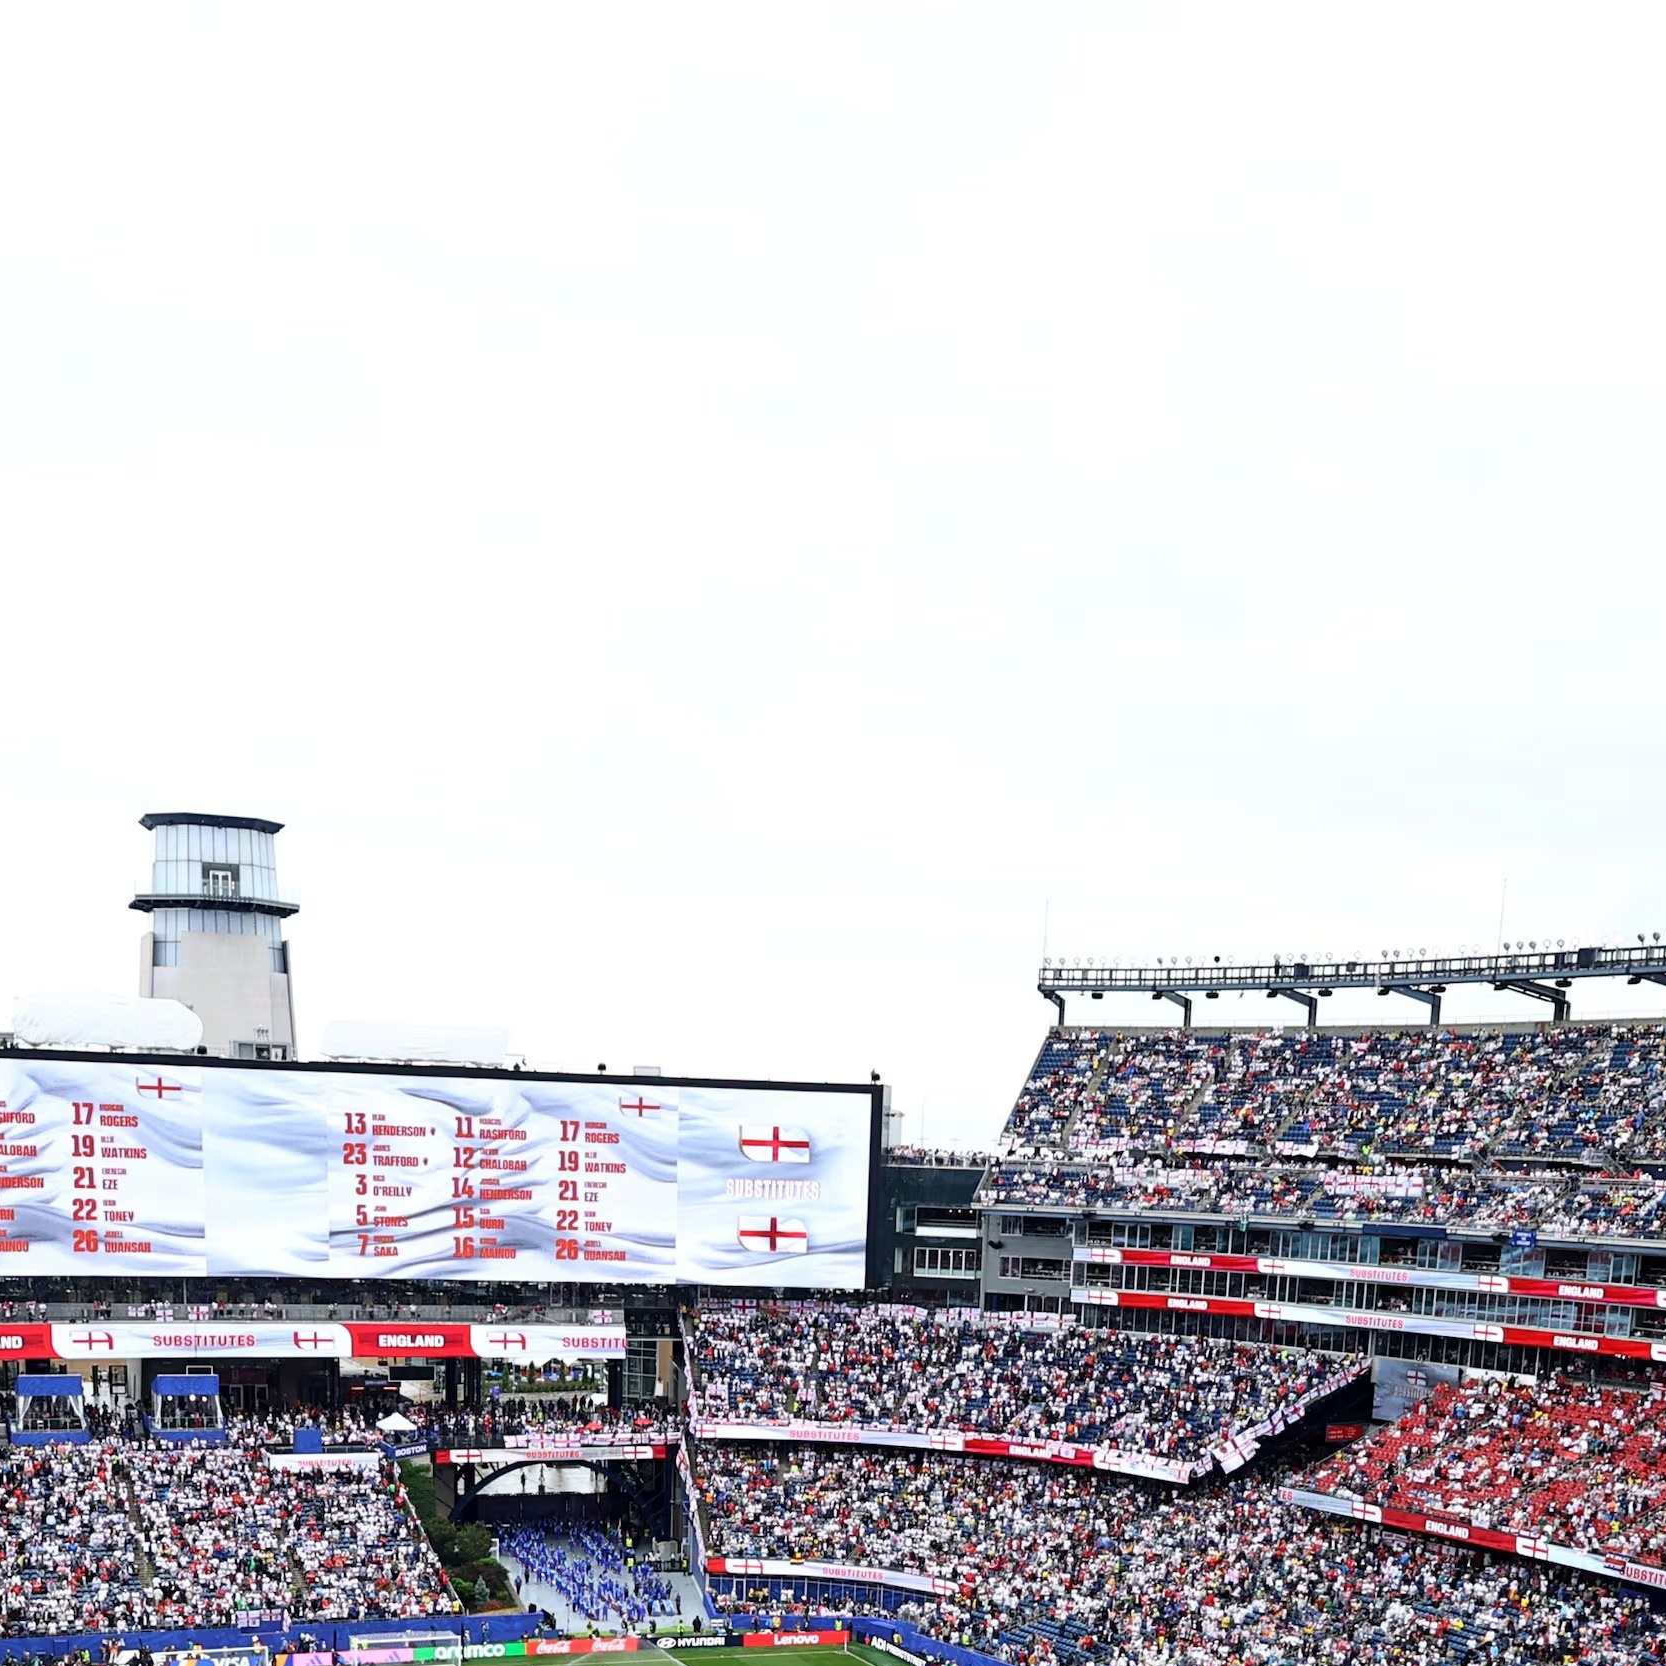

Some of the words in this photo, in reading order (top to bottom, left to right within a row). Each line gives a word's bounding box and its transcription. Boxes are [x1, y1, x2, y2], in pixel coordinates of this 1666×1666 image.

[72, 1102, 95, 1125] 17
[100, 1114, 139, 1128] ROGERS
[345, 1112, 368, 1135] 13
[455, 1116, 475, 1139] 11
[371, 1124, 426, 1137] HENDERSON
[479, 1128, 526, 1141] RASHFORD
[560, 1120, 581, 1142] 17
[585, 1131, 620, 1144] ROGERS
[72, 1134, 96, 1158] 19
[102, 1147, 148, 1159] WATKINS
[342, 1142, 368, 1166] 23
[373, 1155, 419, 1167] TRAFFORD
[453, 1146, 476, 1170] 12
[558, 1150, 580, 1172] 19
[478, 1158, 528, 1172] CHALOBAH
[584, 1162, 626, 1174] WATKINS
[73, 1166, 97, 1190] 21
[102, 1179, 118, 1190] EZE
[355, 1174, 368, 1196] 3
[452, 1176, 475, 1199] 14
[479, 1188, 533, 1201] HENDERSON
[558, 1179, 579, 1201] 21
[726, 1179, 820, 1200] SUBSTITUTES
[584, 1191, 598, 1202] EZE
[72, 1198, 98, 1221] 22
[356, 1204, 369, 1227] 5
[373, 1216, 410, 1227] STONES
[452, 1206, 477, 1230] 15
[556, 1209, 579, 1232] 22
[72, 1228, 100, 1253] 26
[357, 1233, 370, 1256] 7
[452, 1236, 477, 1259] 16
[373, 1246, 398, 1257] SAKA
[554, 1238, 581, 1261] 26
[1171, 1255, 1211, 1268] ENGLAND
[1351, 1270, 1407, 1280] SUBSTITUTES
[1559, 1285, 1604, 1299] ENGLAND
[1168, 1299, 1207, 1311] ENGLAND
[1347, 1316, 1403, 1328] SUBSTITUTES
[154, 1335, 255, 1347] SUBSTITUTES
[379, 1335, 444, 1347] ENGLAND
[1554, 1336, 1599, 1350] ENGLAND
[790, 1430, 860, 1440] SUBSTITUTES
[394, 1444, 428, 1457] BOSTON
[1425, 1520, 1469, 1540] ENGLAND
[823, 1568, 883, 1579] SUBSTITUTES
[677, 1636, 726, 1648] HYUNDAI
[773, 1633, 820, 1646] Lenovo
